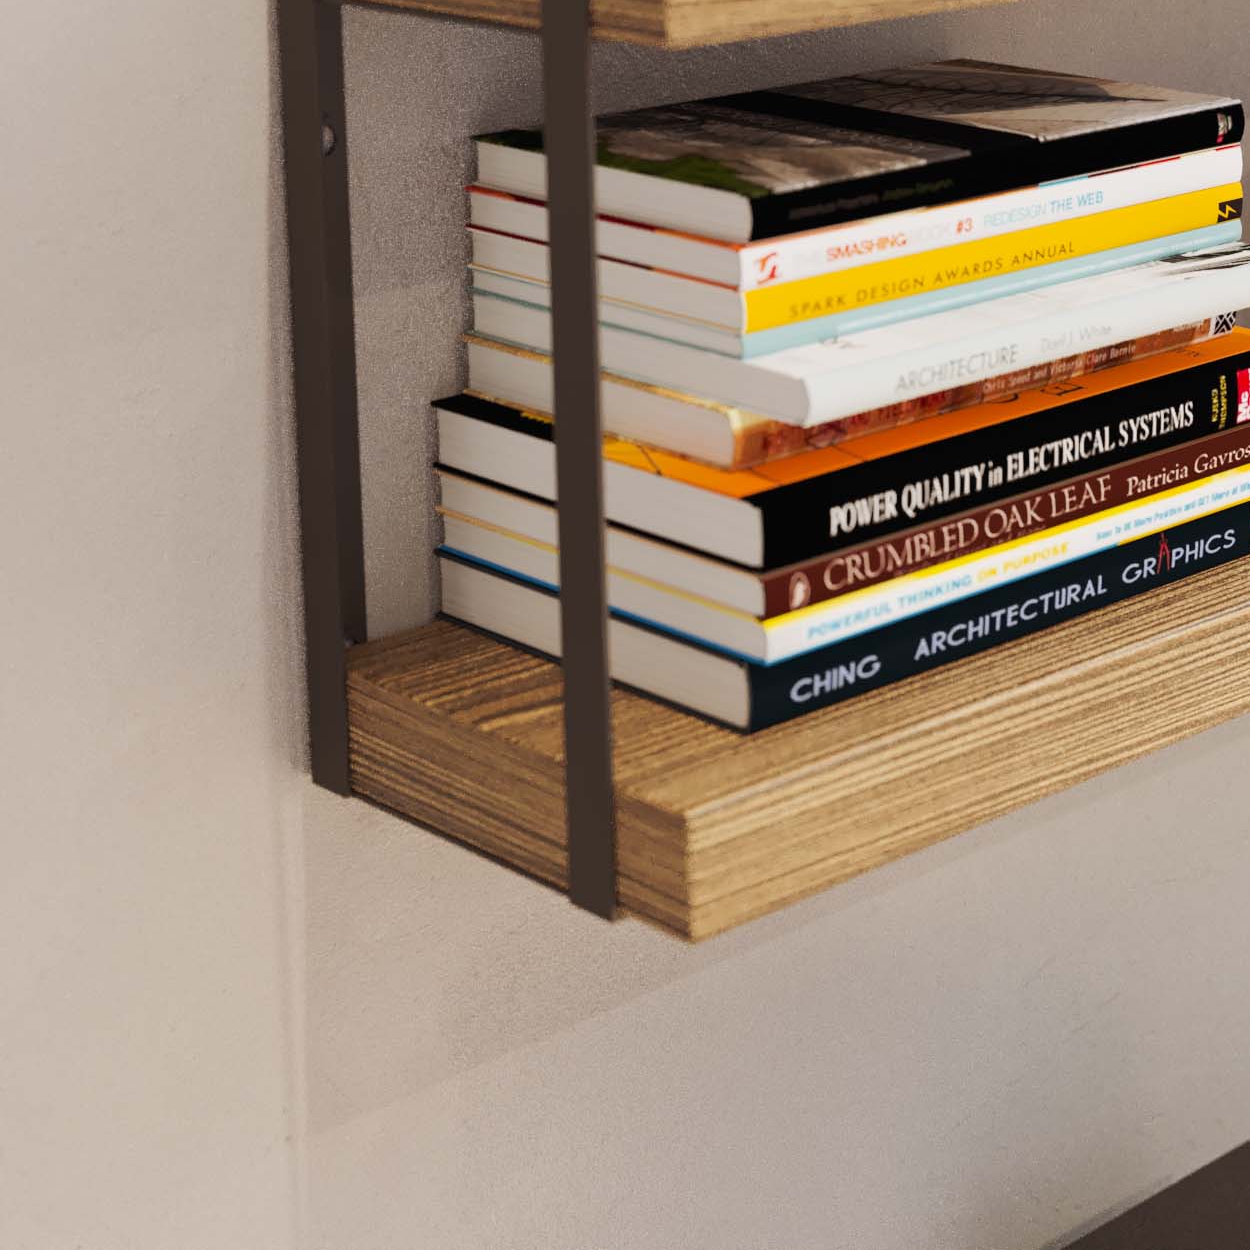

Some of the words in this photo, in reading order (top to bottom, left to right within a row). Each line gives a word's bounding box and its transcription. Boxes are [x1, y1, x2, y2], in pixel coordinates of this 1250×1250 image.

[826, 233, 907, 262] SMASHING
[956, 217, 974, 235] #3
[1050, 197, 1073, 215] THE
[1076, 190, 1104, 207] WEB
[789, 294, 847, 318] SPARK
[856, 277, 924, 303] DESIGN
[933, 257, 1004, 284] AWARDS
[1011, 241, 1075, 267] ANNUAL
[896, 345, 1019, 391] ARCHITECTURE
[1237, 391, 1249, 423] Mc
[829, 491, 898, 537] POWER
[901, 462, 986, 518] QUALITY
[988, 461, 1002, 488] in
[1006, 426, 1115, 483] ELECTRICAL
[1118, 401, 1195, 447] SYSTEMS
[823, 521, 979, 591] CRUMBLED
[984, 497, 1044, 539] OAK
[1050, 475, 1113, 518] LEAF
[1126, 464, 1189, 496] Patricia
[790, 654, 882, 703] CHING
[913, 575, 1108, 661] ARCHITECTURAL
[1121, 529, 1238, 585] GRAPHICS
[807, 602, 893, 639] POWERFUL
[897, 574, 973, 607] THINKING
[977, 567, 998, 582] ON
[1002, 541, 1070, 573] PURPOSE
